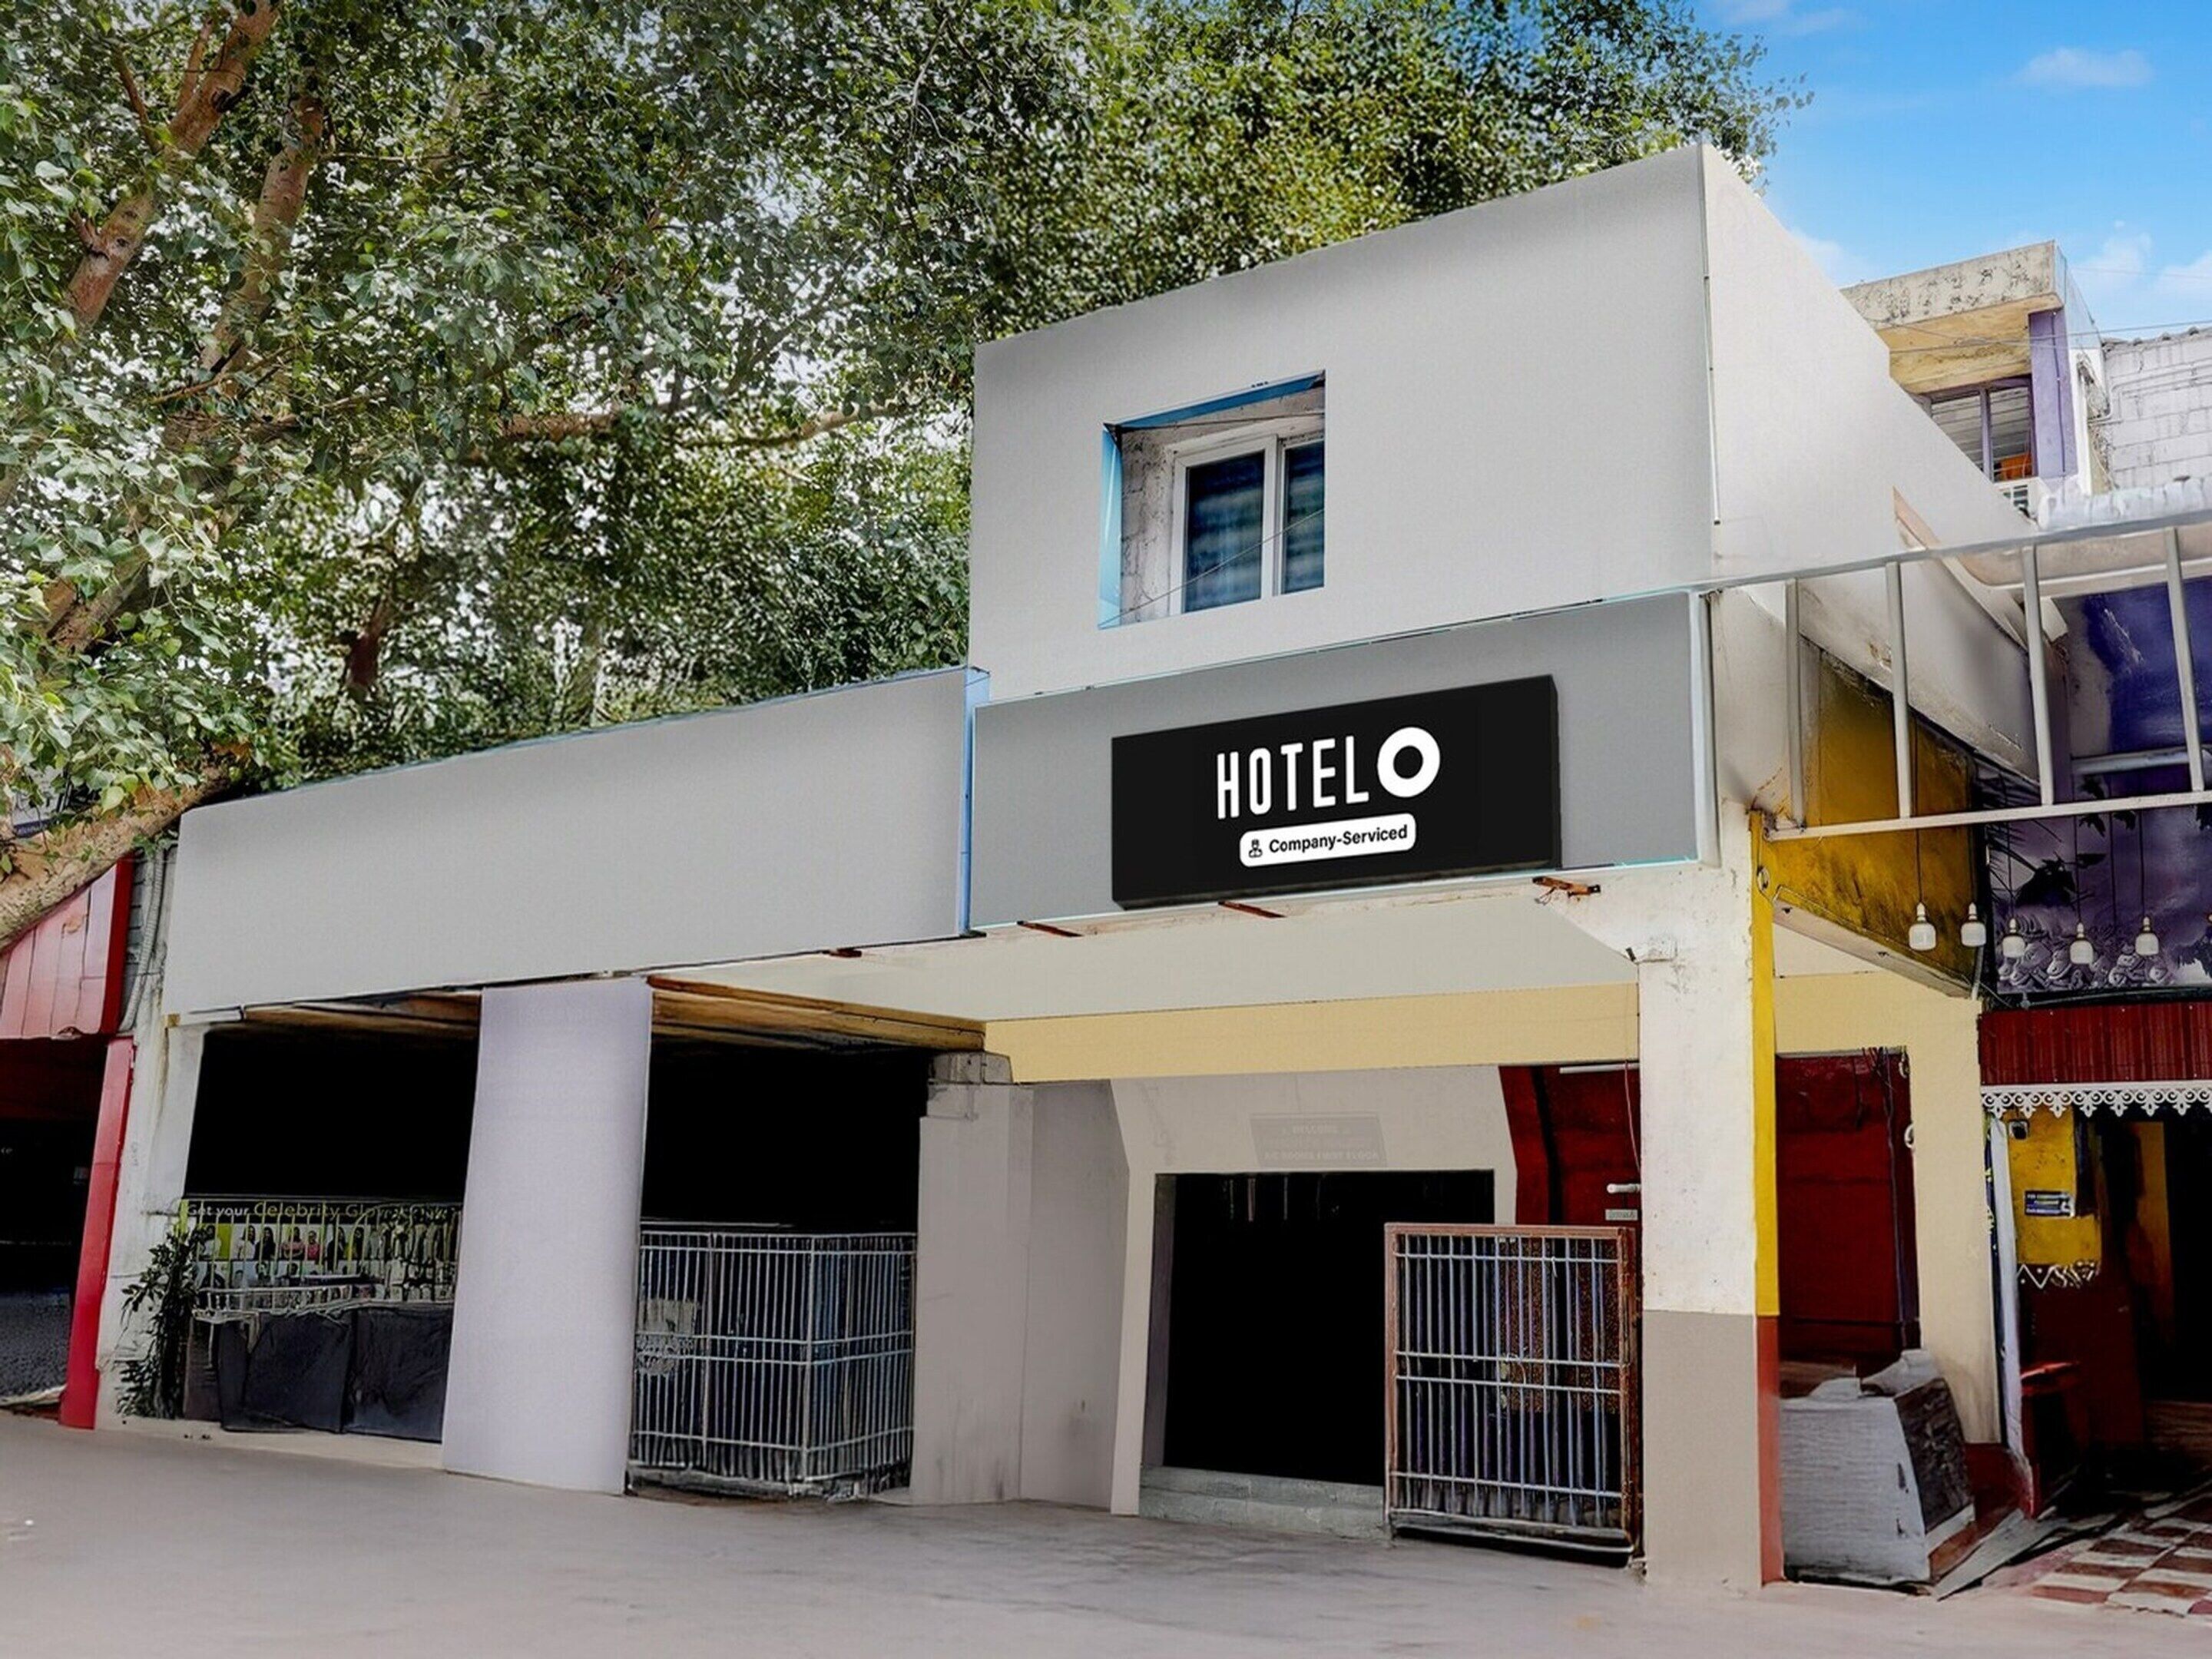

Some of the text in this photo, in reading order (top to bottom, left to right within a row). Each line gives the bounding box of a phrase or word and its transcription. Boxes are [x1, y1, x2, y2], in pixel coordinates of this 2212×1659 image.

[1217, 736, 1369, 820] HOTEL
[1269, 824, 1408, 853] Company-Serviced
[216, 1207, 250, 1217] your
[254, 1202, 340, 1220] Celebrity
